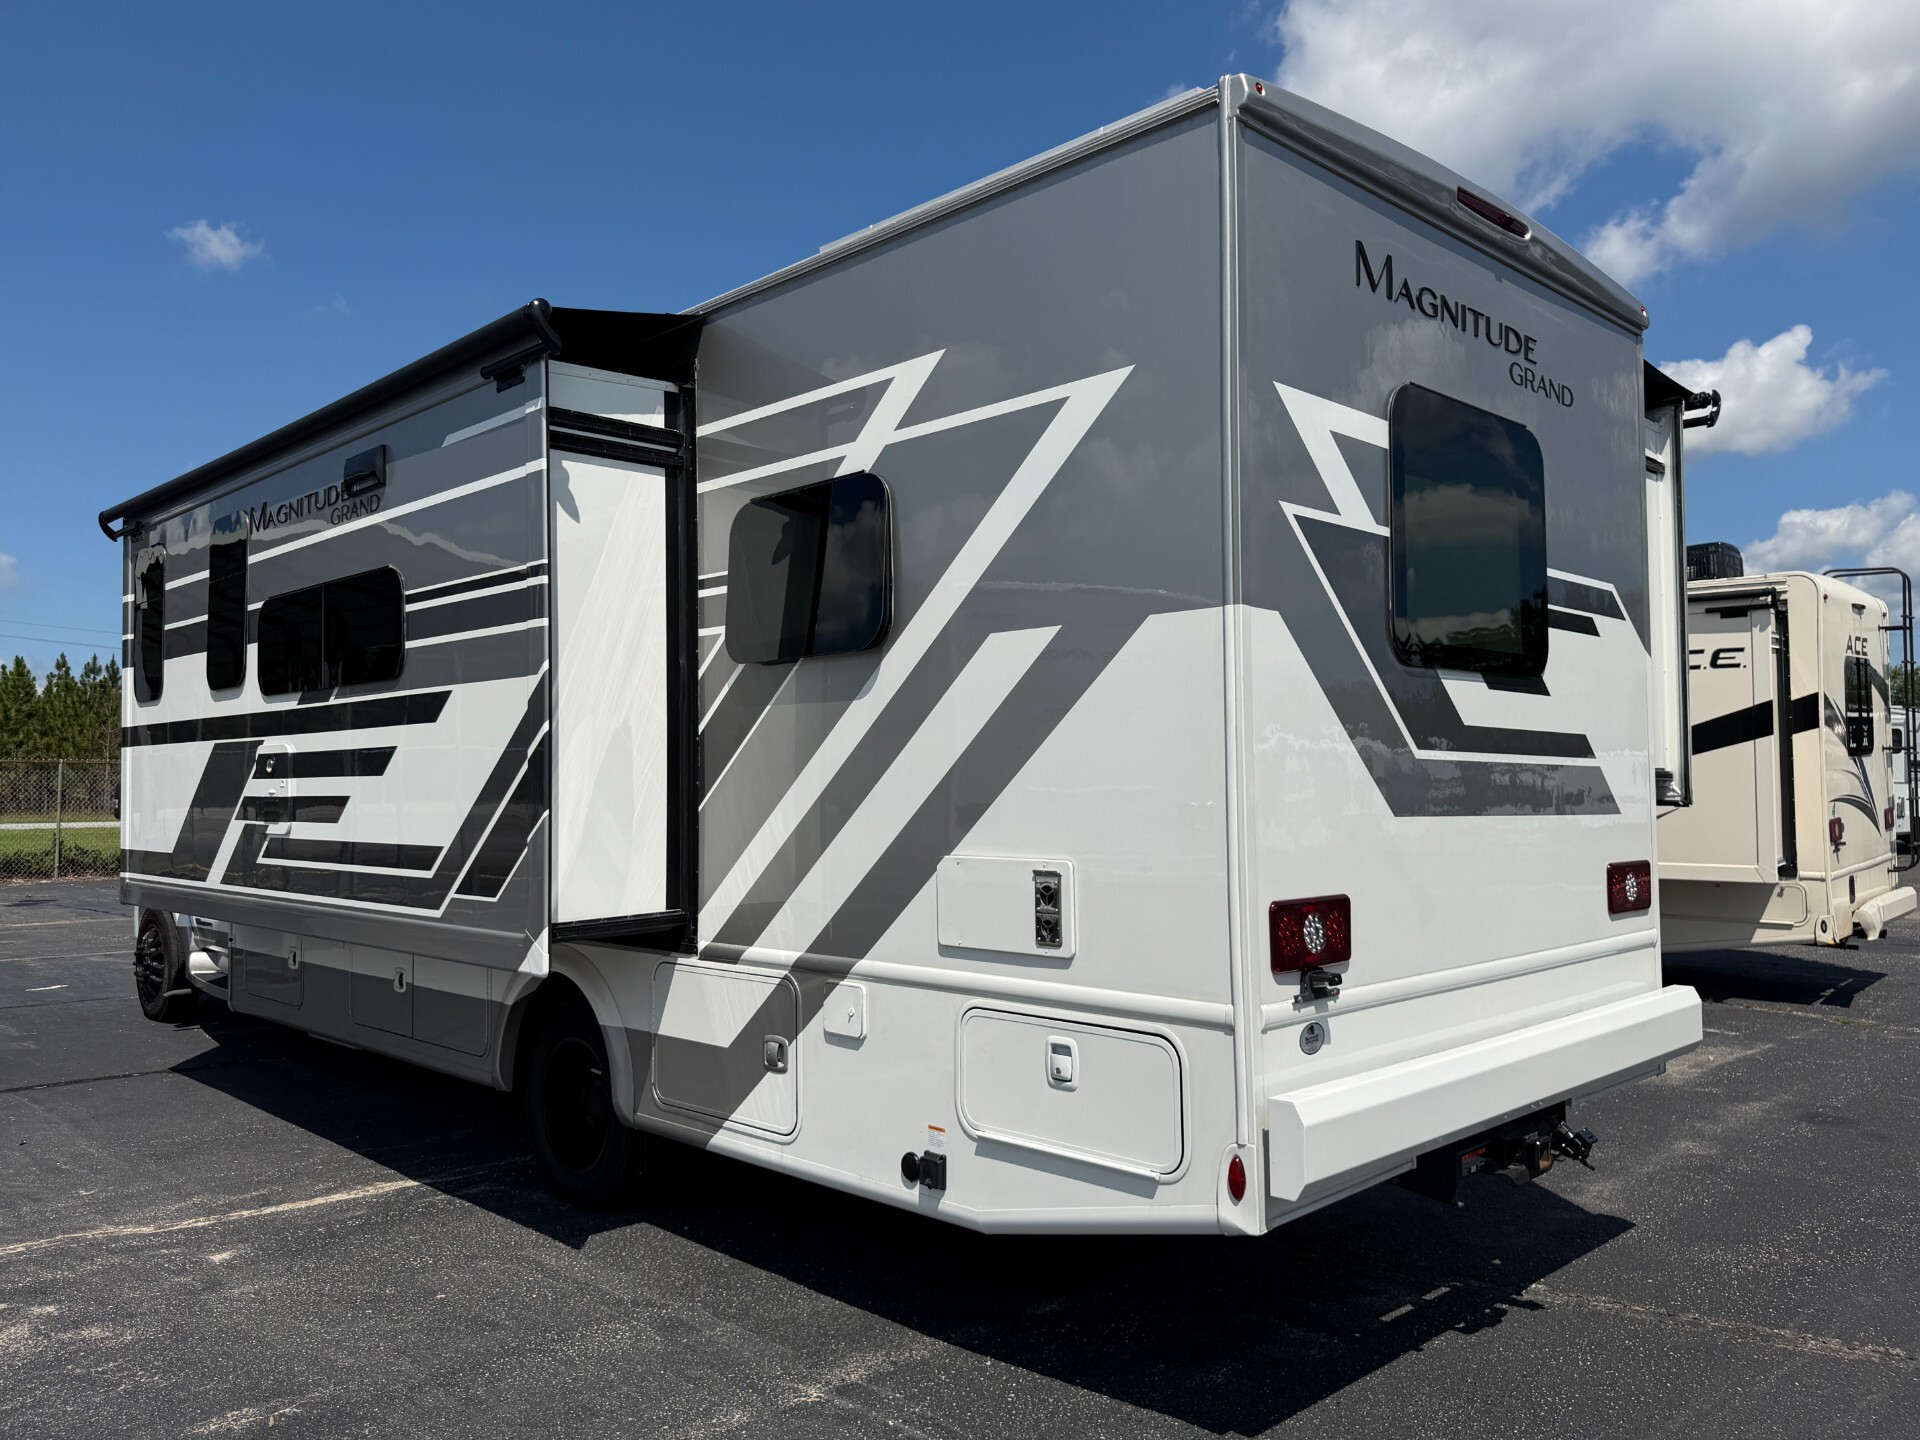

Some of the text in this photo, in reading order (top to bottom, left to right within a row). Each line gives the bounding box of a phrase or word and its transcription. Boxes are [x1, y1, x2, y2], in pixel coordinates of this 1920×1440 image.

[1355, 240, 1537, 365] MAGNITUDE
[1509, 361, 1574, 408] GRAND
[330, 494, 380, 525] GRAND
[1845, 634, 1868, 656] ACE
